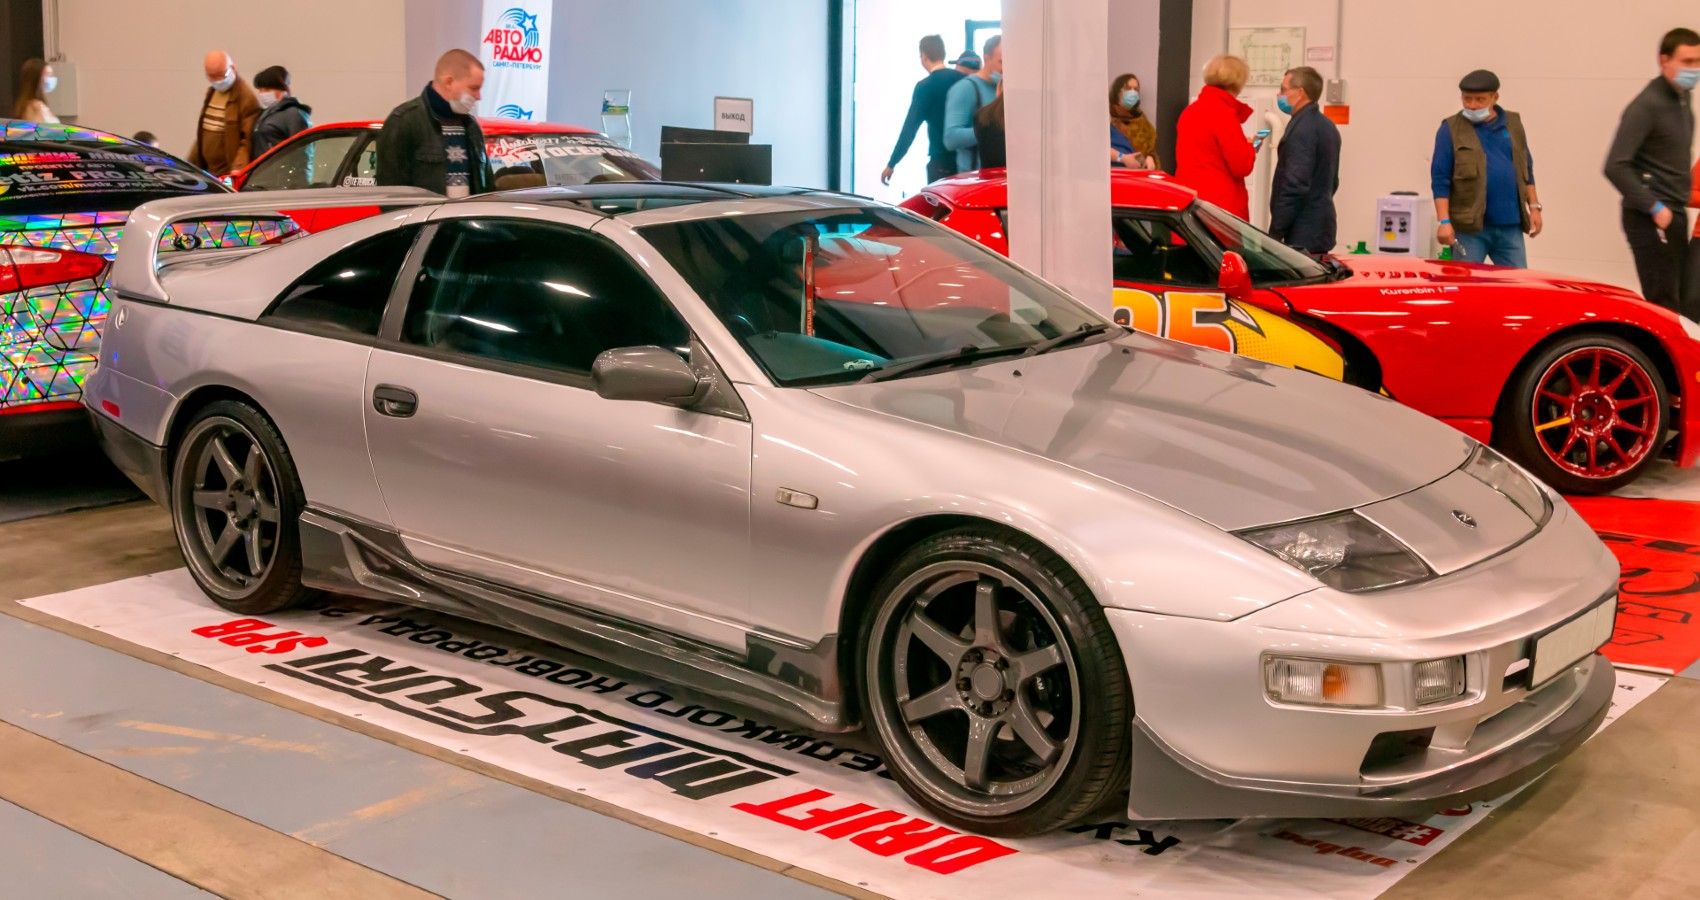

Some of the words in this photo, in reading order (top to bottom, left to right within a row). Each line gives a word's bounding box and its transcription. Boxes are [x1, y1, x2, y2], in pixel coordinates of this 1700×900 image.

[484, 29, 523, 46] АВТО
[493, 45, 543, 63] РАДИО
[721, 112, 746, 122] ВЫХОД
[69, 170, 187, 182] PROJECT
[1379, 287, 1436, 296] Kurenbin
[190, 617, 329, 656] SPB
[264, 648, 798, 801] MATSURI
[731, 787, 1020, 876] DRIFT
